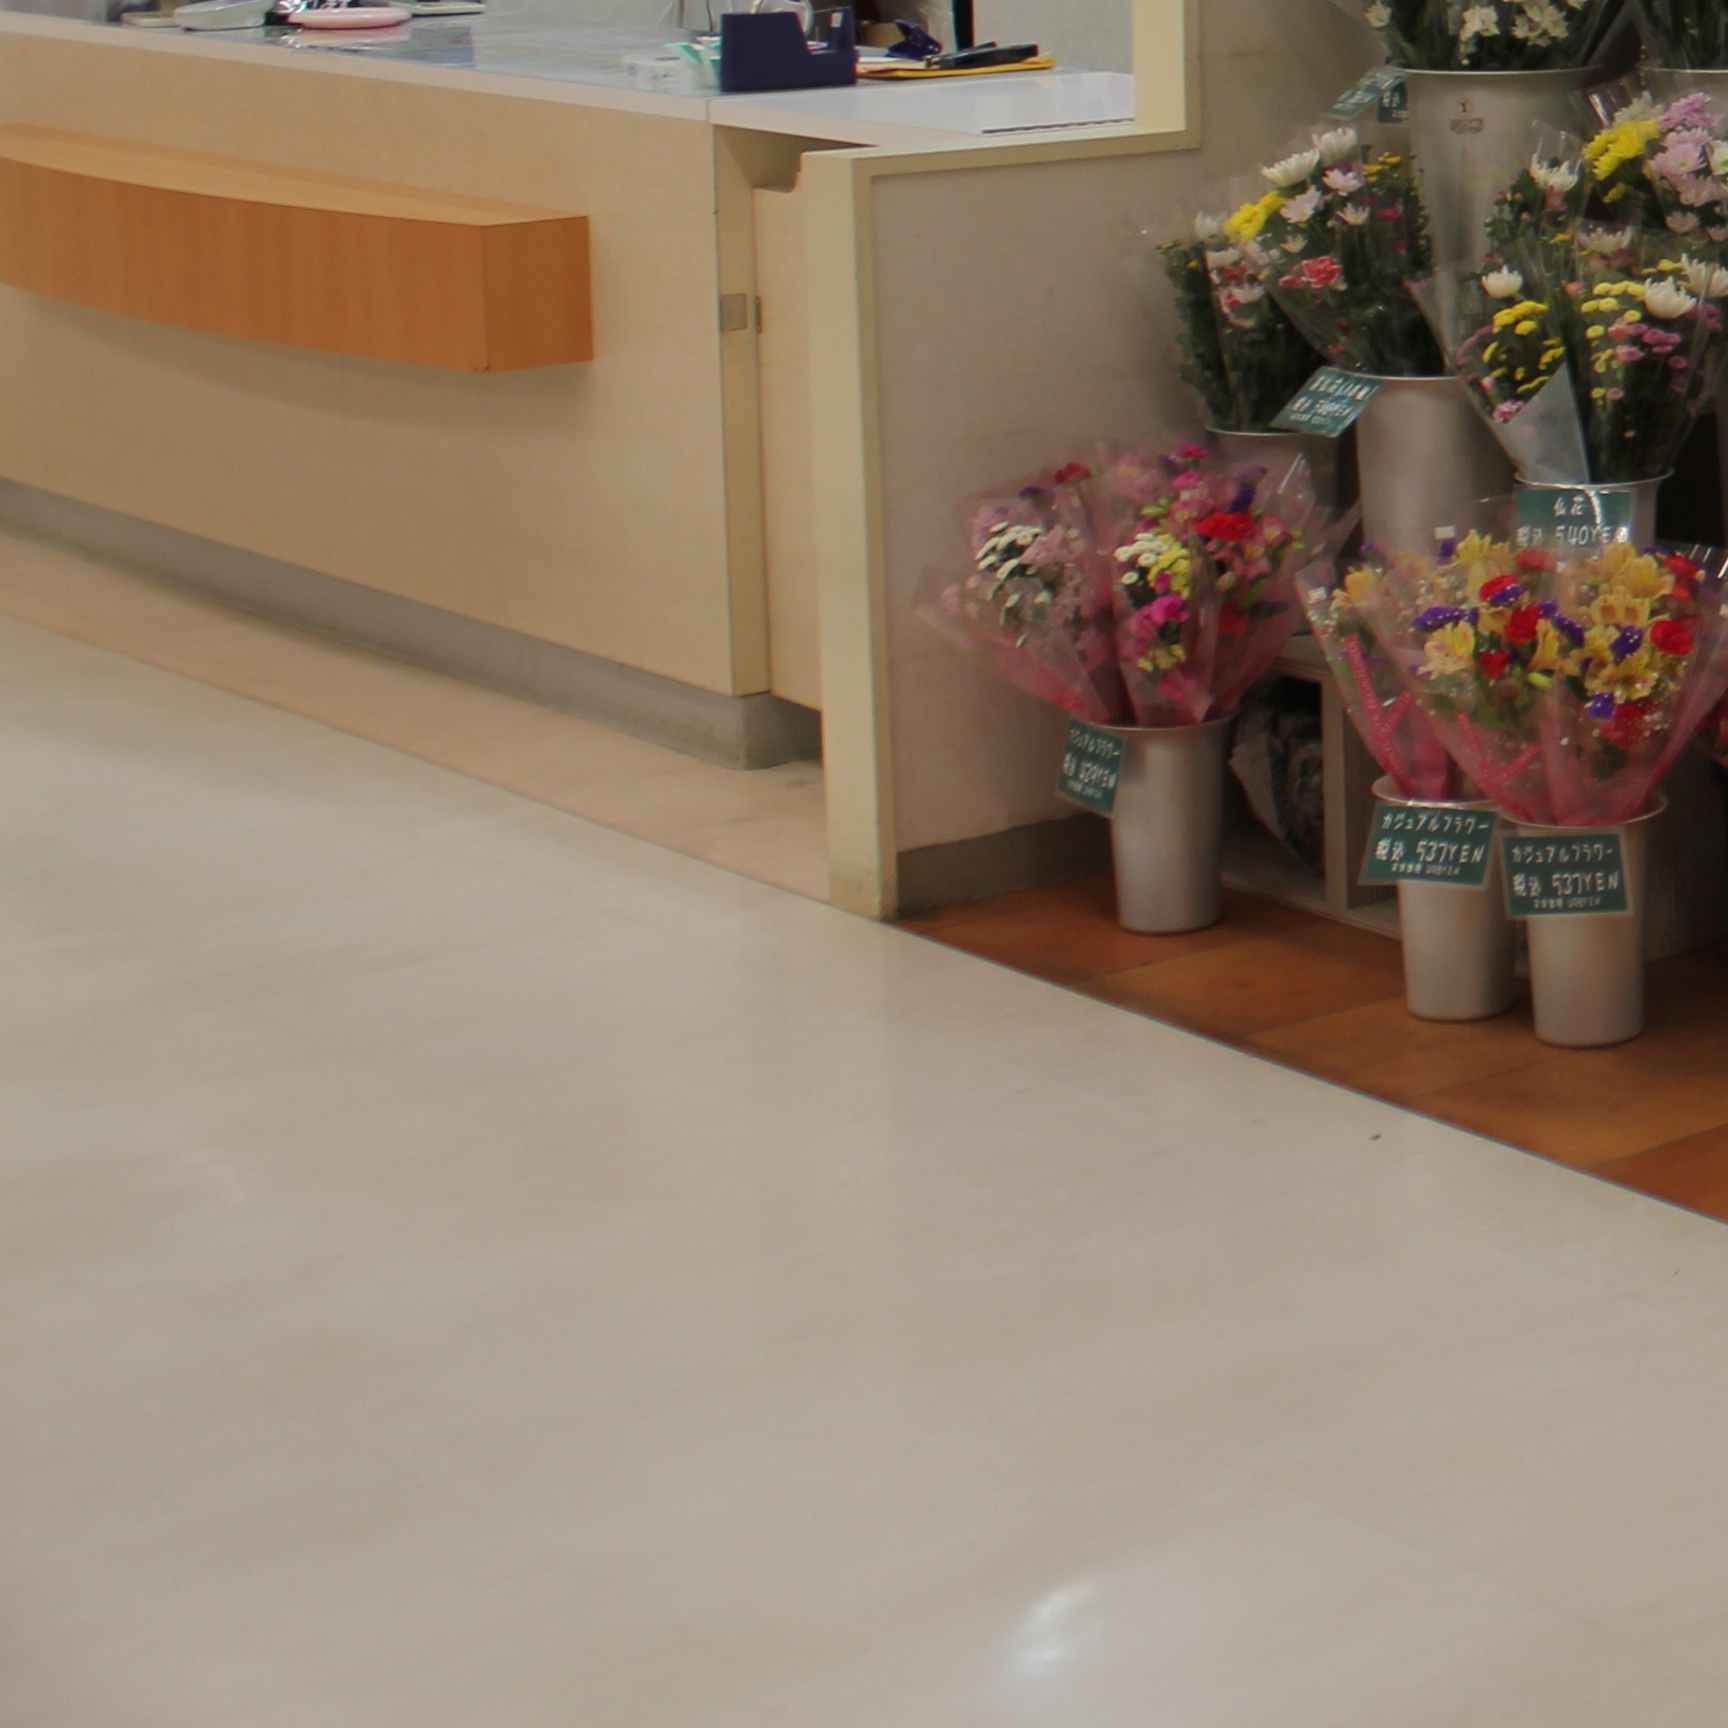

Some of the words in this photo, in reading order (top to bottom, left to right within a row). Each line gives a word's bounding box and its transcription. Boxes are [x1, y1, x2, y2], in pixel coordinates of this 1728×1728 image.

[1381, 810, 1489, 834] カジュアルフラワー
[1375, 837, 1405, 862] 税込
[1415, 838, 1485, 863] 537YEN
[1511, 843, 1613, 864] カジュアルフラワー
[1512, 873, 1542, 897] 税込
[1551, 870, 1619, 895] 537YEN
